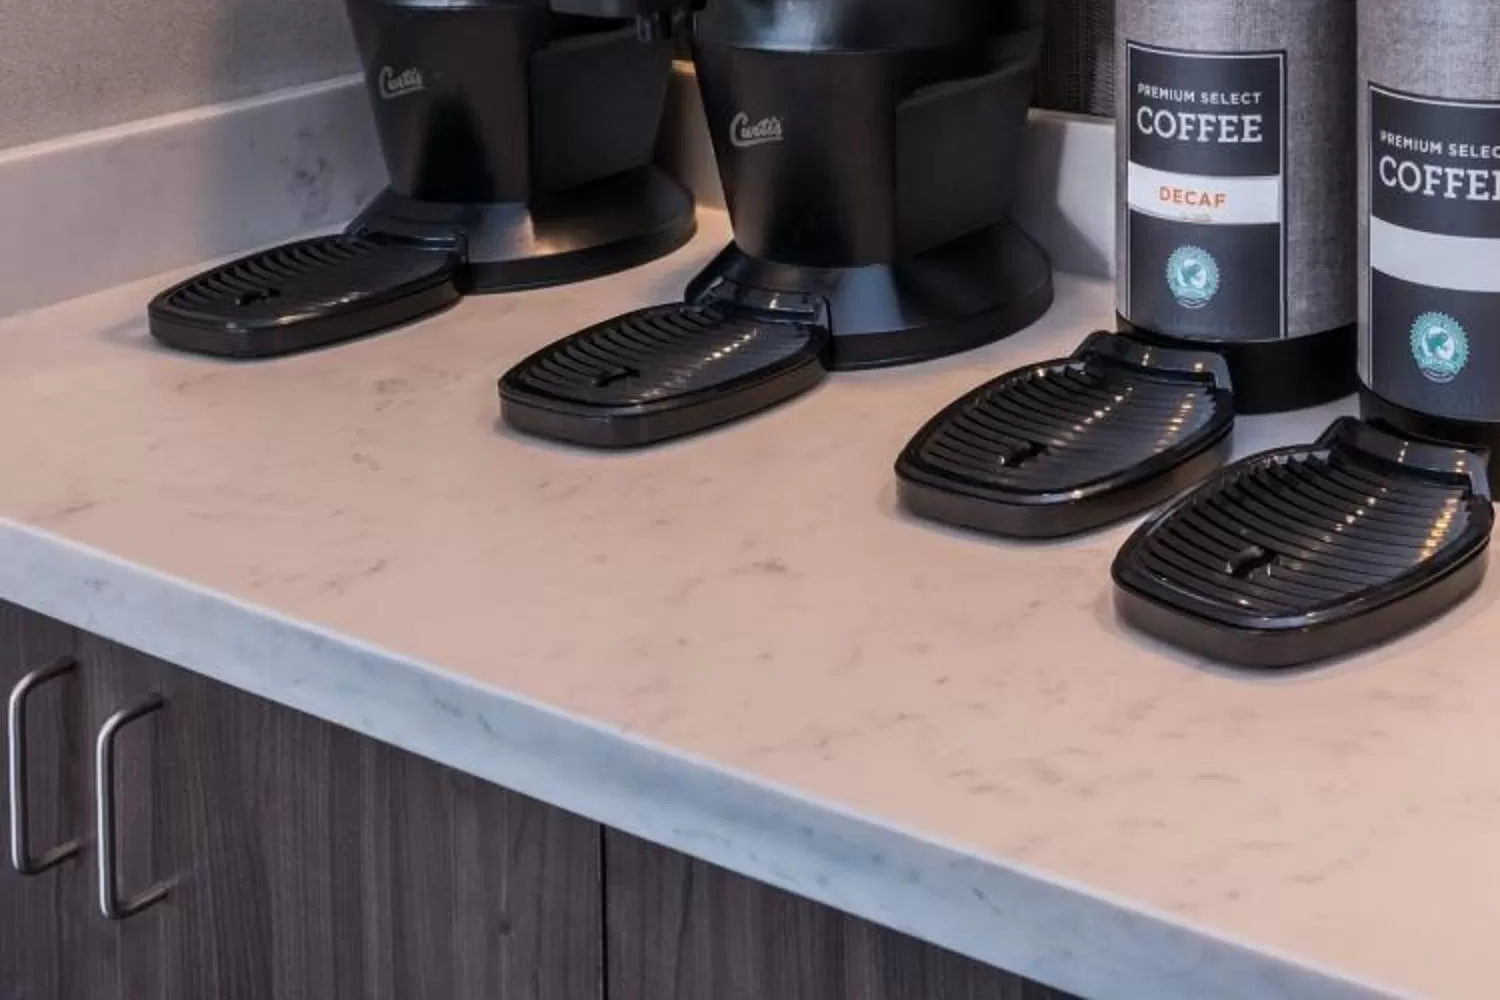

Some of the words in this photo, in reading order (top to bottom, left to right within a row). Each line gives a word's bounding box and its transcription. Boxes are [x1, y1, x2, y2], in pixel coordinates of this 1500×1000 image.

[1137, 82, 1196, 104] PREMIUM
[1200, 91, 1262, 105] SELECT
[1136, 106, 1263, 143] COFFEE
[1379, 130, 1443, 155] PREMIUM
[1159, 186, 1227, 208] DECAF
